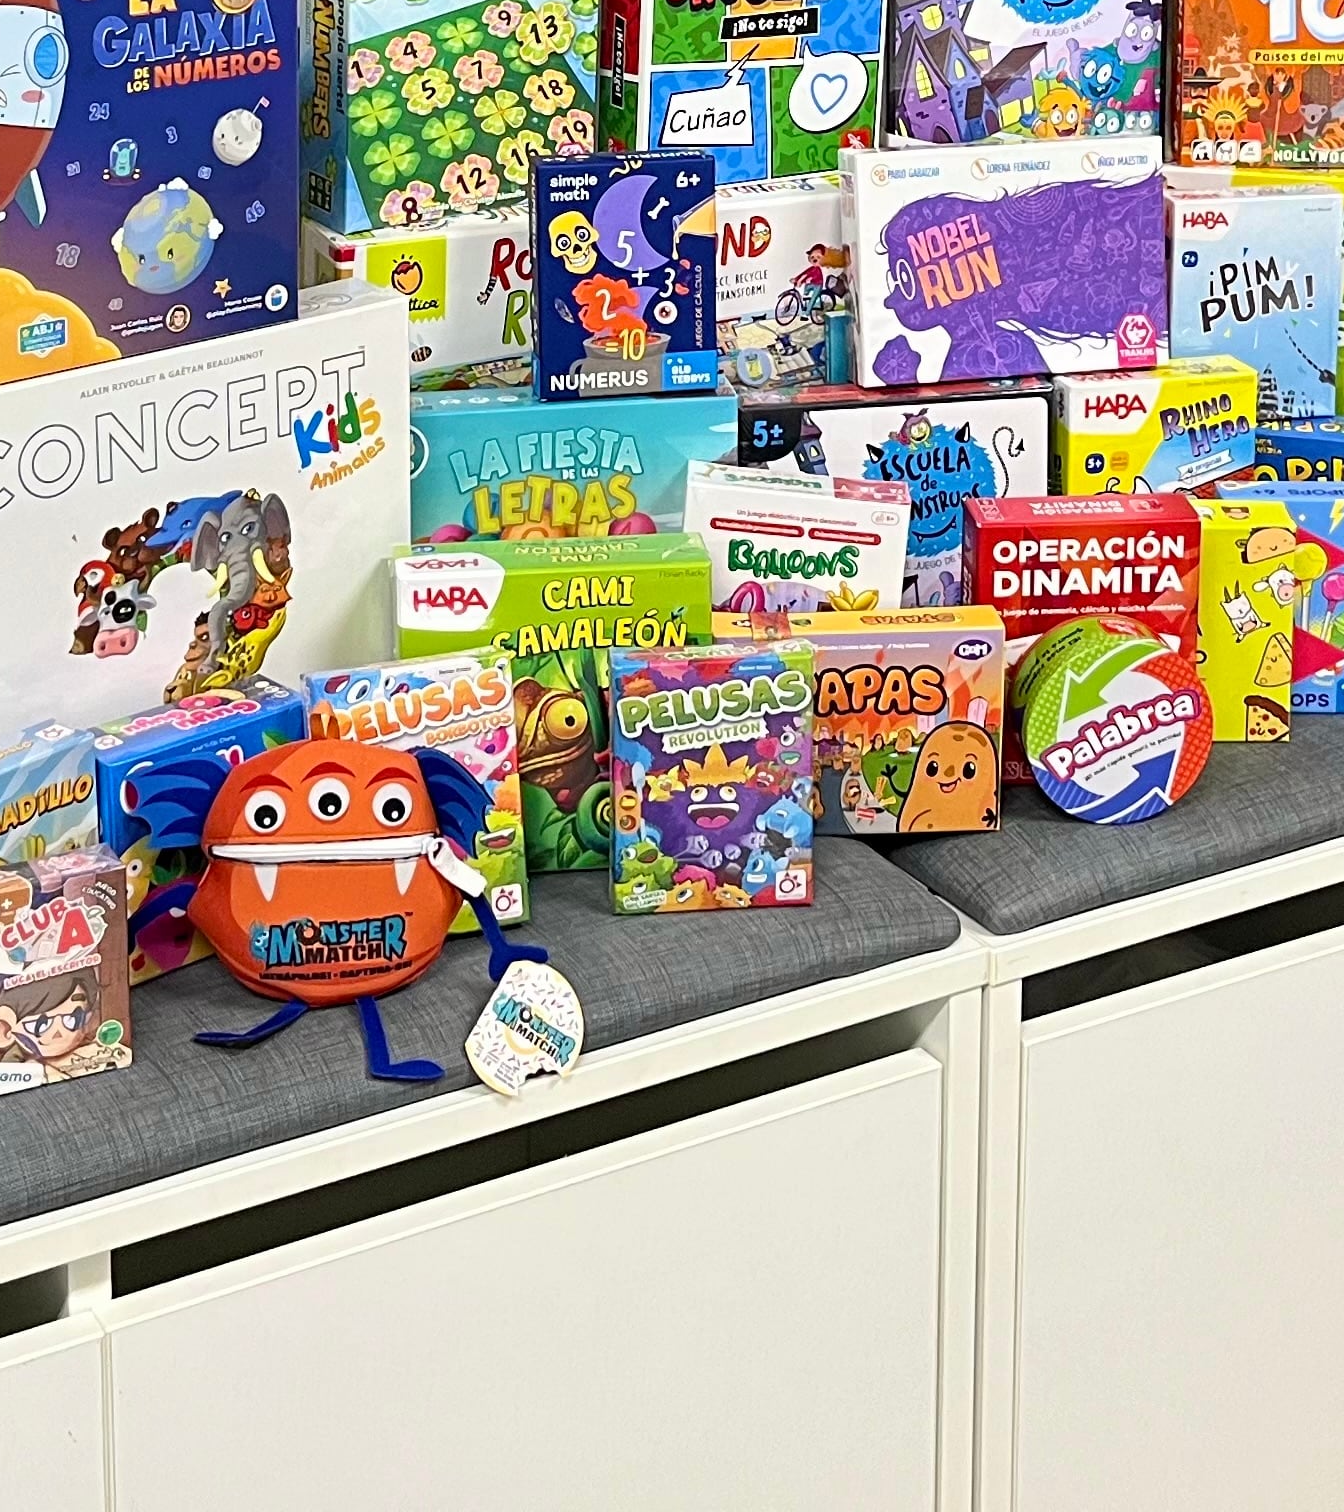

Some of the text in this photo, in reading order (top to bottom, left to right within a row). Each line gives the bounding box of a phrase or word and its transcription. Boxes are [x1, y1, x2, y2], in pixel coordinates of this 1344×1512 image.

[133, 67, 150, 79] DE
[153, 48, 282, 88] NÚMEROS
[1301, 51, 1321, 62] del
[127, 79, 150, 94] LOS
[669, 105, 746, 133] Cuñao
[549, 173, 598, 191] simple
[550, 188, 590, 202] math
[1182, 211, 1229, 229] HABA
[907, 213, 991, 267] NOBEL
[916, 245, 1002, 310] RUN
[1200, 275, 1314, 333] PUM!
[80, 385, 110, 399] ALAIN
[111, 376, 156, 394] RIVOLLET
[550, 369, 649, 392] NUMERUS
[1084, 393, 1147, 419] HABA
[1159, 393, 1232, 441] RHINO
[293, 391, 383, 471] Kids
[1189, 415, 1251, 457] HERO
[309, 436, 387, 491] Animales
[450, 427, 644, 493] LA FIESTA
[562, 467, 599, 480] DE LAS
[880, 446, 972, 482] ESCUELA
[922, 478, 938, 490] de
[472, 473, 638, 535] LETRAS
[993, 531, 1185, 564] OPERACIÓN
[542, 576, 635, 611] CAMI
[993, 565, 1184, 598] DINAMITA
[413, 586, 488, 615] HABA
[492, 608, 687, 659] CAMALEÓN
[619, 673, 809, 736] PELUSAS
[424, 711, 513, 744] BORBOTOS
[668, 721, 761, 748] REVOLUTION
[1046, 694, 1196, 778] Palabrea
[1, 900, 95, 954] CLUB A
[267, 913, 408, 969] MONSTER
[305, 941, 386, 965] MATCH
[515, 1022, 558, 1061] MATCH
